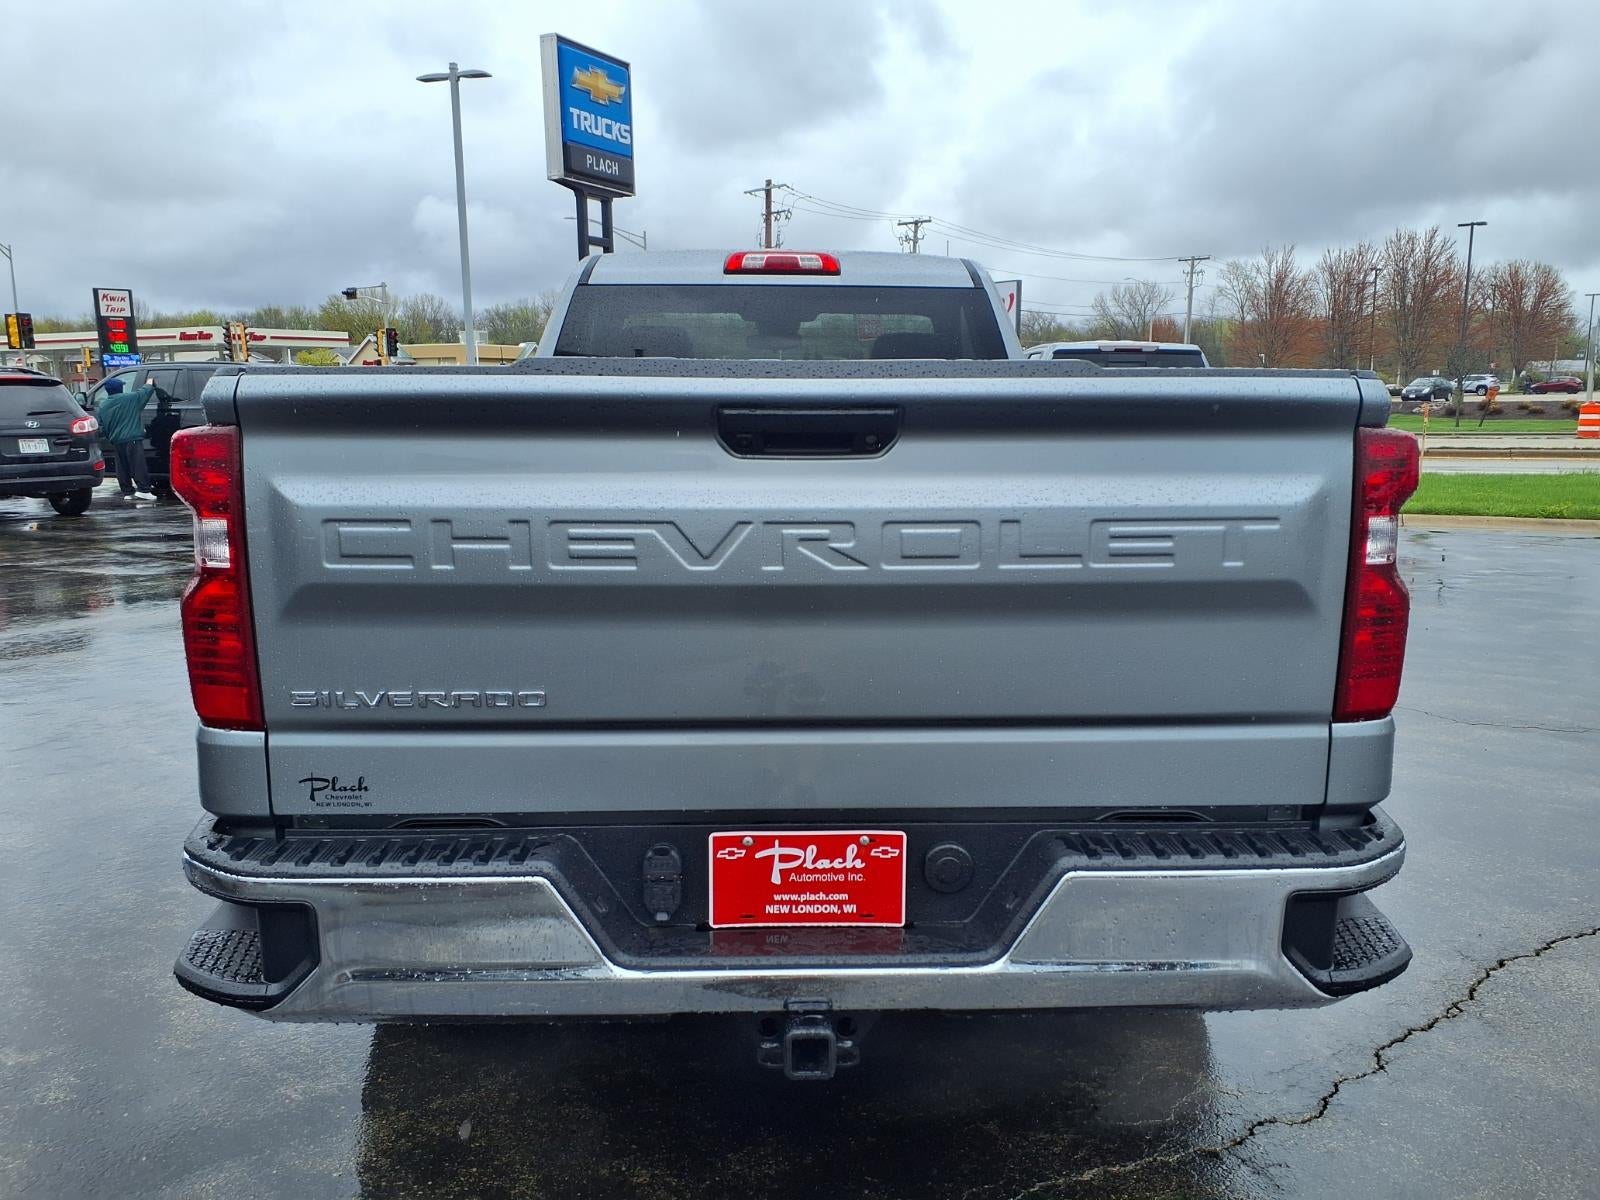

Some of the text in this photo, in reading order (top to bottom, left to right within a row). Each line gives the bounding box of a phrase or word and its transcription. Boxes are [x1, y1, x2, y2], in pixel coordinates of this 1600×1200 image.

[569, 107, 631, 145] TRUCKS
[586, 154, 619, 175] PLACH
[101, 293, 127, 303] KWIK
[105, 304, 126, 313] TRIP
[321, 518, 1281, 571] CHEVROLET
[290, 690, 547, 708] SILVERADO
[298, 772, 370, 802] Plach
[325, 793, 363, 801] Chevrolet
[754, 838, 867, 885] Plach
[788, 871, 867, 882] Automotive Inc.
[773, 891, 849, 903] www.plach.com
[765, 903, 858, 915] NEW LONDON, WI
